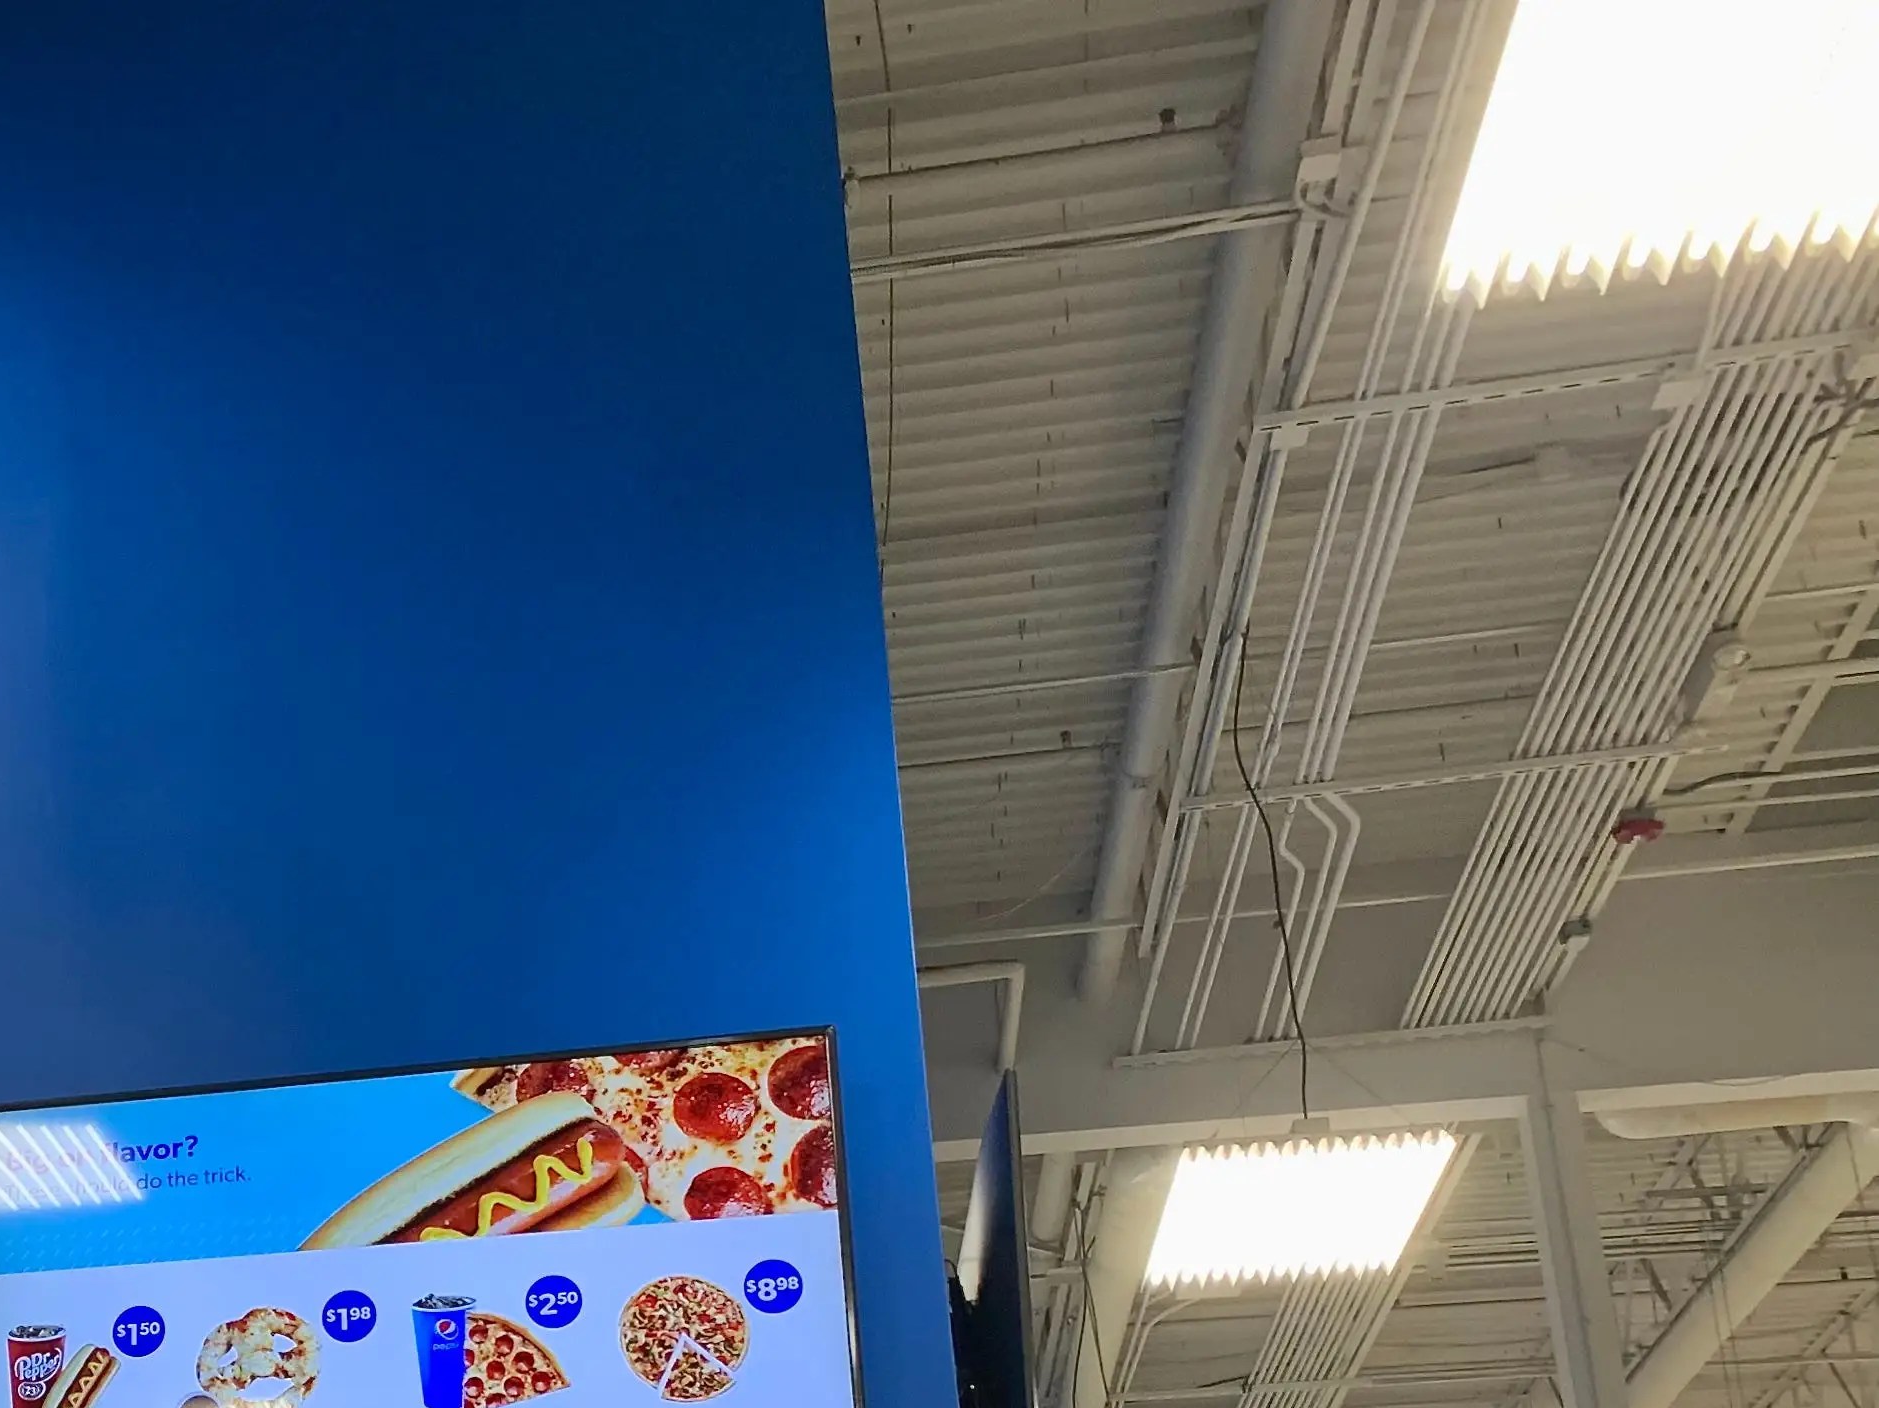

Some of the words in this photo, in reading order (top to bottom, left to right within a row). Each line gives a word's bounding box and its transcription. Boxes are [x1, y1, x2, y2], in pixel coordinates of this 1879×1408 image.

[136, 1172, 162, 1190] do
[167, 1170, 199, 1187] the
[204, 1165, 252, 1185] trick.
